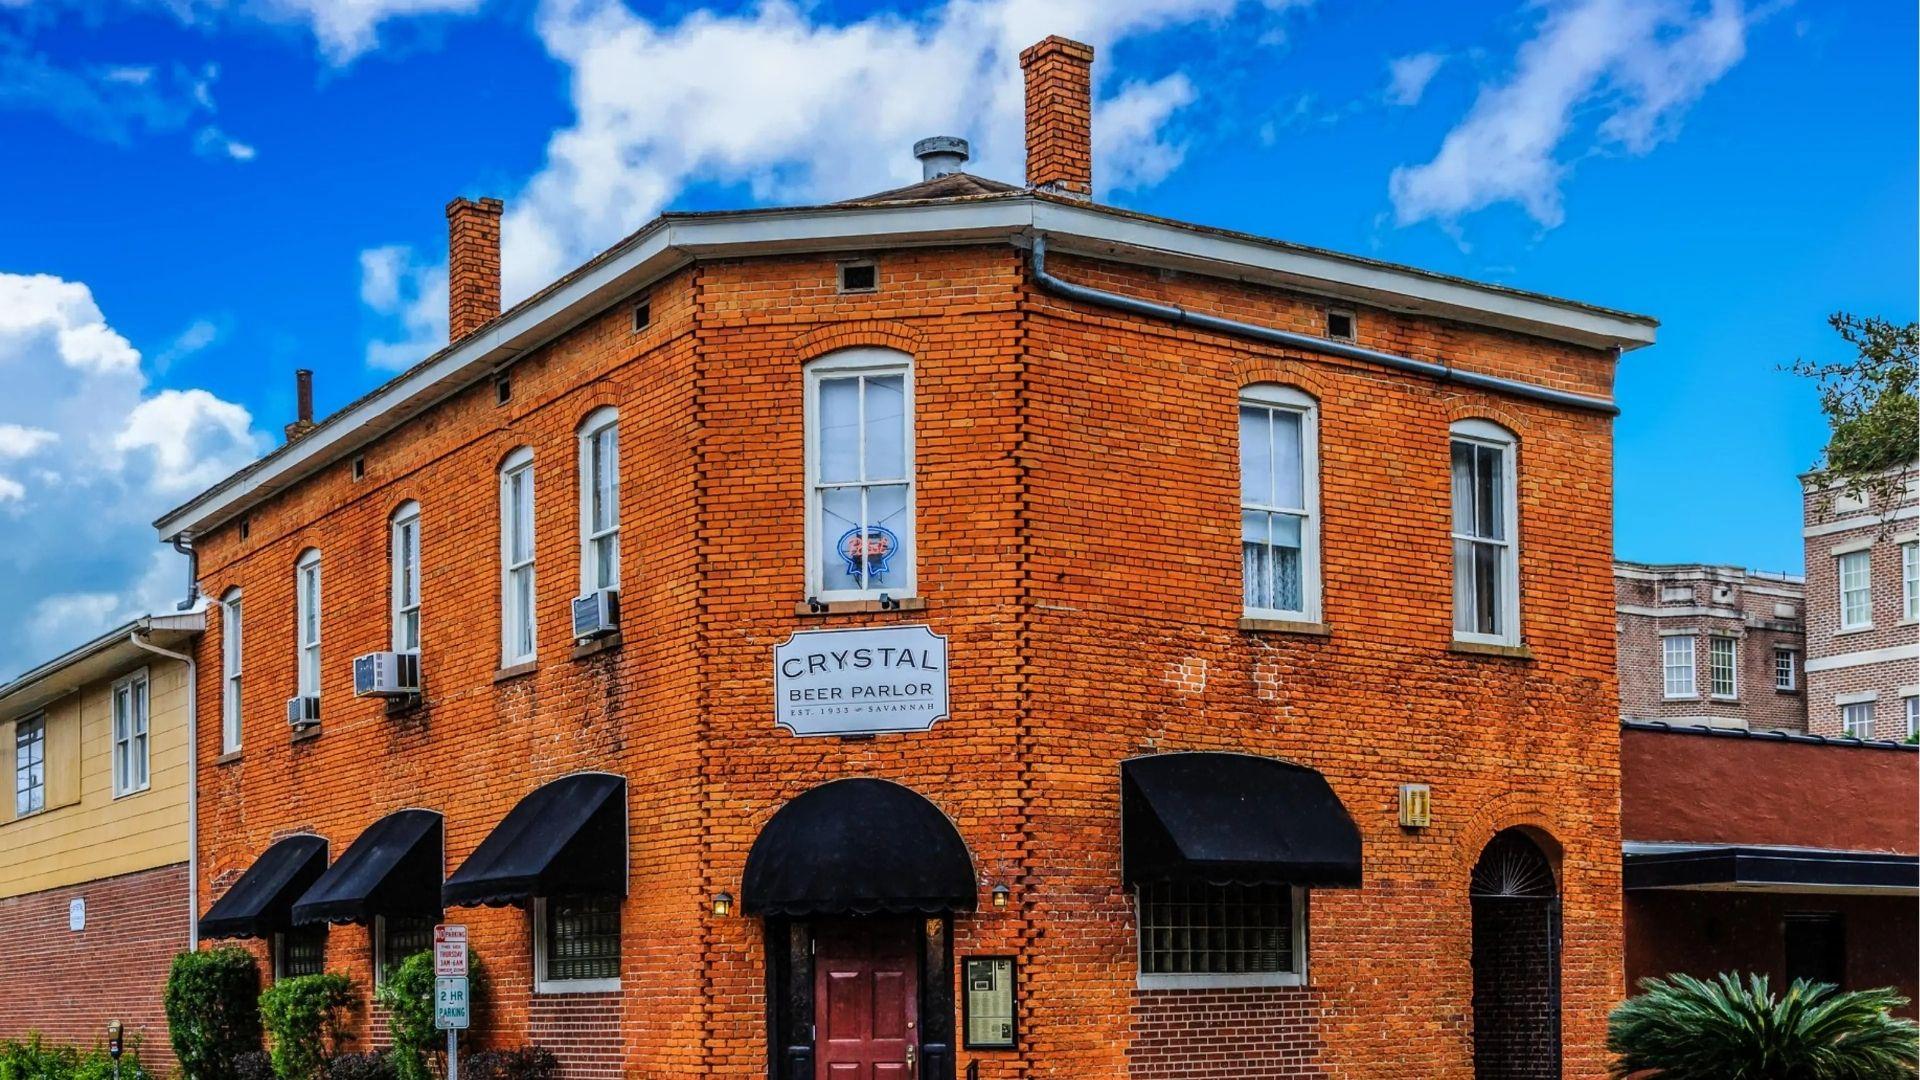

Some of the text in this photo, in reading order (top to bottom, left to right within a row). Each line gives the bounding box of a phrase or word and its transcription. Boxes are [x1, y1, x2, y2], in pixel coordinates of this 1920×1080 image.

[782, 648, 939, 678] CRYSTAL
[789, 683, 934, 701] BEER PARLOR
[790, 708, 815, 716] EST.
[868, 703, 934, 713] SAVANNAH
[441, 991, 463, 1001] 2 HR
[439, 1007, 465, 1018] PARKING
